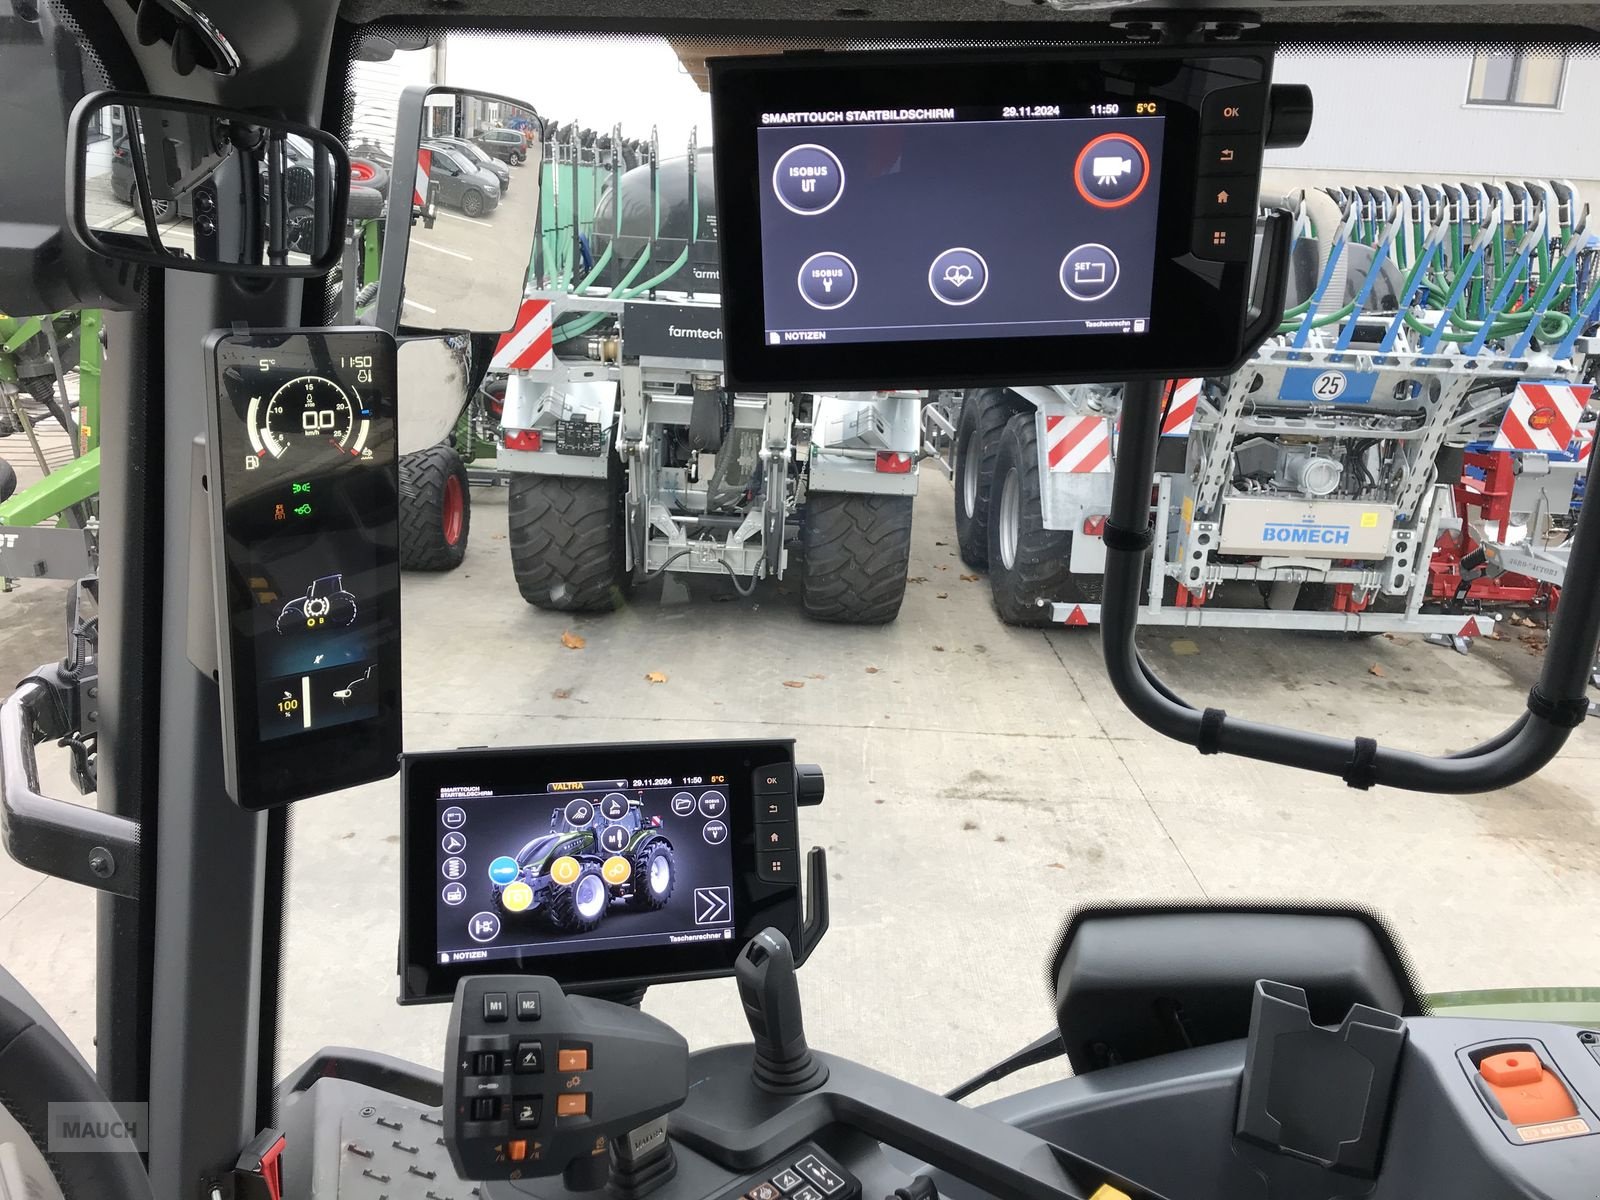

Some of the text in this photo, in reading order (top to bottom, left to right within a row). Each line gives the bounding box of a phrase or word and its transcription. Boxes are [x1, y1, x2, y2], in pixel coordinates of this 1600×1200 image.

[1002, 105, 1060, 117] 29.11.2024
[1090, 103, 1119, 115] 11:50
[1136, 102, 1157, 114] 5°C
[1223, 107, 1240, 118] OK
[761, 108, 955, 124] SMARTTOUCH STARTBILDSCHIRM
[789, 166, 828, 177] ISOBUS
[801, 179, 816, 193] UT
[1074, 262, 1092, 271] SET
[811, 269, 844, 278] ISOBUS
[669, 325, 723, 339] farmtech
[784, 330, 827, 342] NOTIZEN
[340, 355, 373, 369] 11:50
[304, 383, 314, 391] 15
[1316, 374, 1343, 395] 25
[273, 406, 283, 414] 10
[335, 403, 345, 411] 20
[333, 430, 342, 438] 25
[1262, 526, 1350, 545] BOMECH
[277, 700, 298, 712] 100
[632, 777, 672, 787] 29.11.2024
[682, 777, 702, 785] 11:50
[711, 775, 725, 784] 5°C
[766, 776, 778, 785] OK
[552, 783, 584, 791] VALTRA
[669, 932, 722, 942] Taschenrechner
[453, 951, 488, 960] NOTIZEN
[490, 1002, 502, 1010] M1
[522, 1000, 536, 1009] M2
